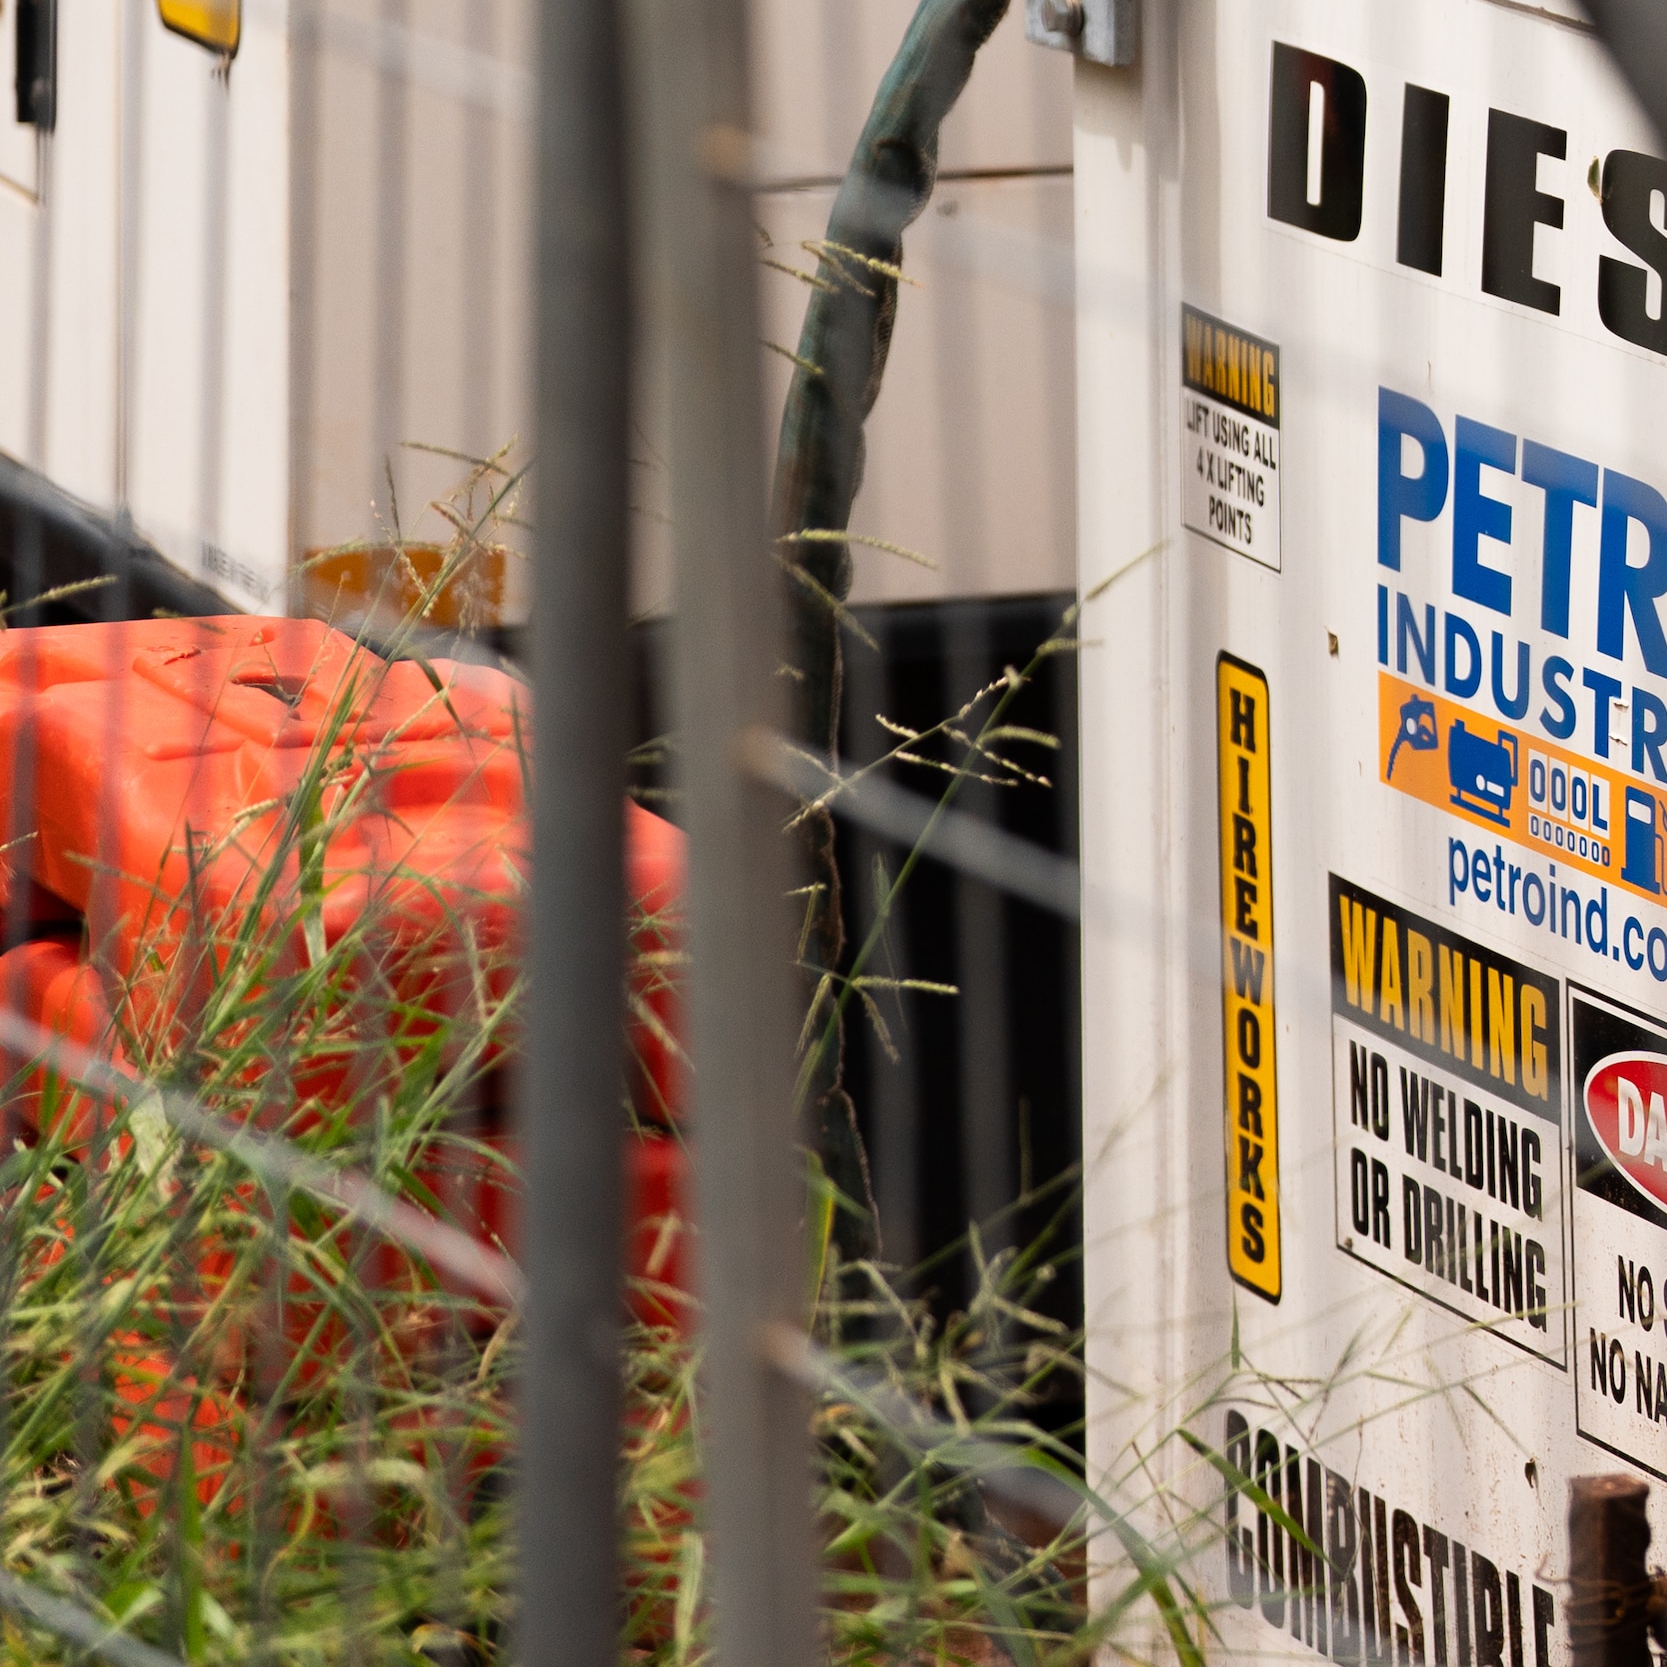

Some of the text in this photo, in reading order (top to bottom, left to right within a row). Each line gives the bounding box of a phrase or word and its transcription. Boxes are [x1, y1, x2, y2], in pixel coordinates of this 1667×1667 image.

[1185, 314, 1275, 418] WARNING
[1186, 397, 1276, 470] LIFT USING ALL
[1196, 446, 1264, 507] 4 X LIFTING
[1209, 495, 1252, 545] POINTS
[1228, 687, 1265, 1264] HIREWORKS
[1339, 894, 1548, 1101] WARNING
[1349, 1039, 1542, 1222] NO WELDING
[1351, 1147, 1547, 1333] OR DRILLING
[1617, 1255, 1654, 1332] NO
[1590, 1327, 1626, 1404] NO
